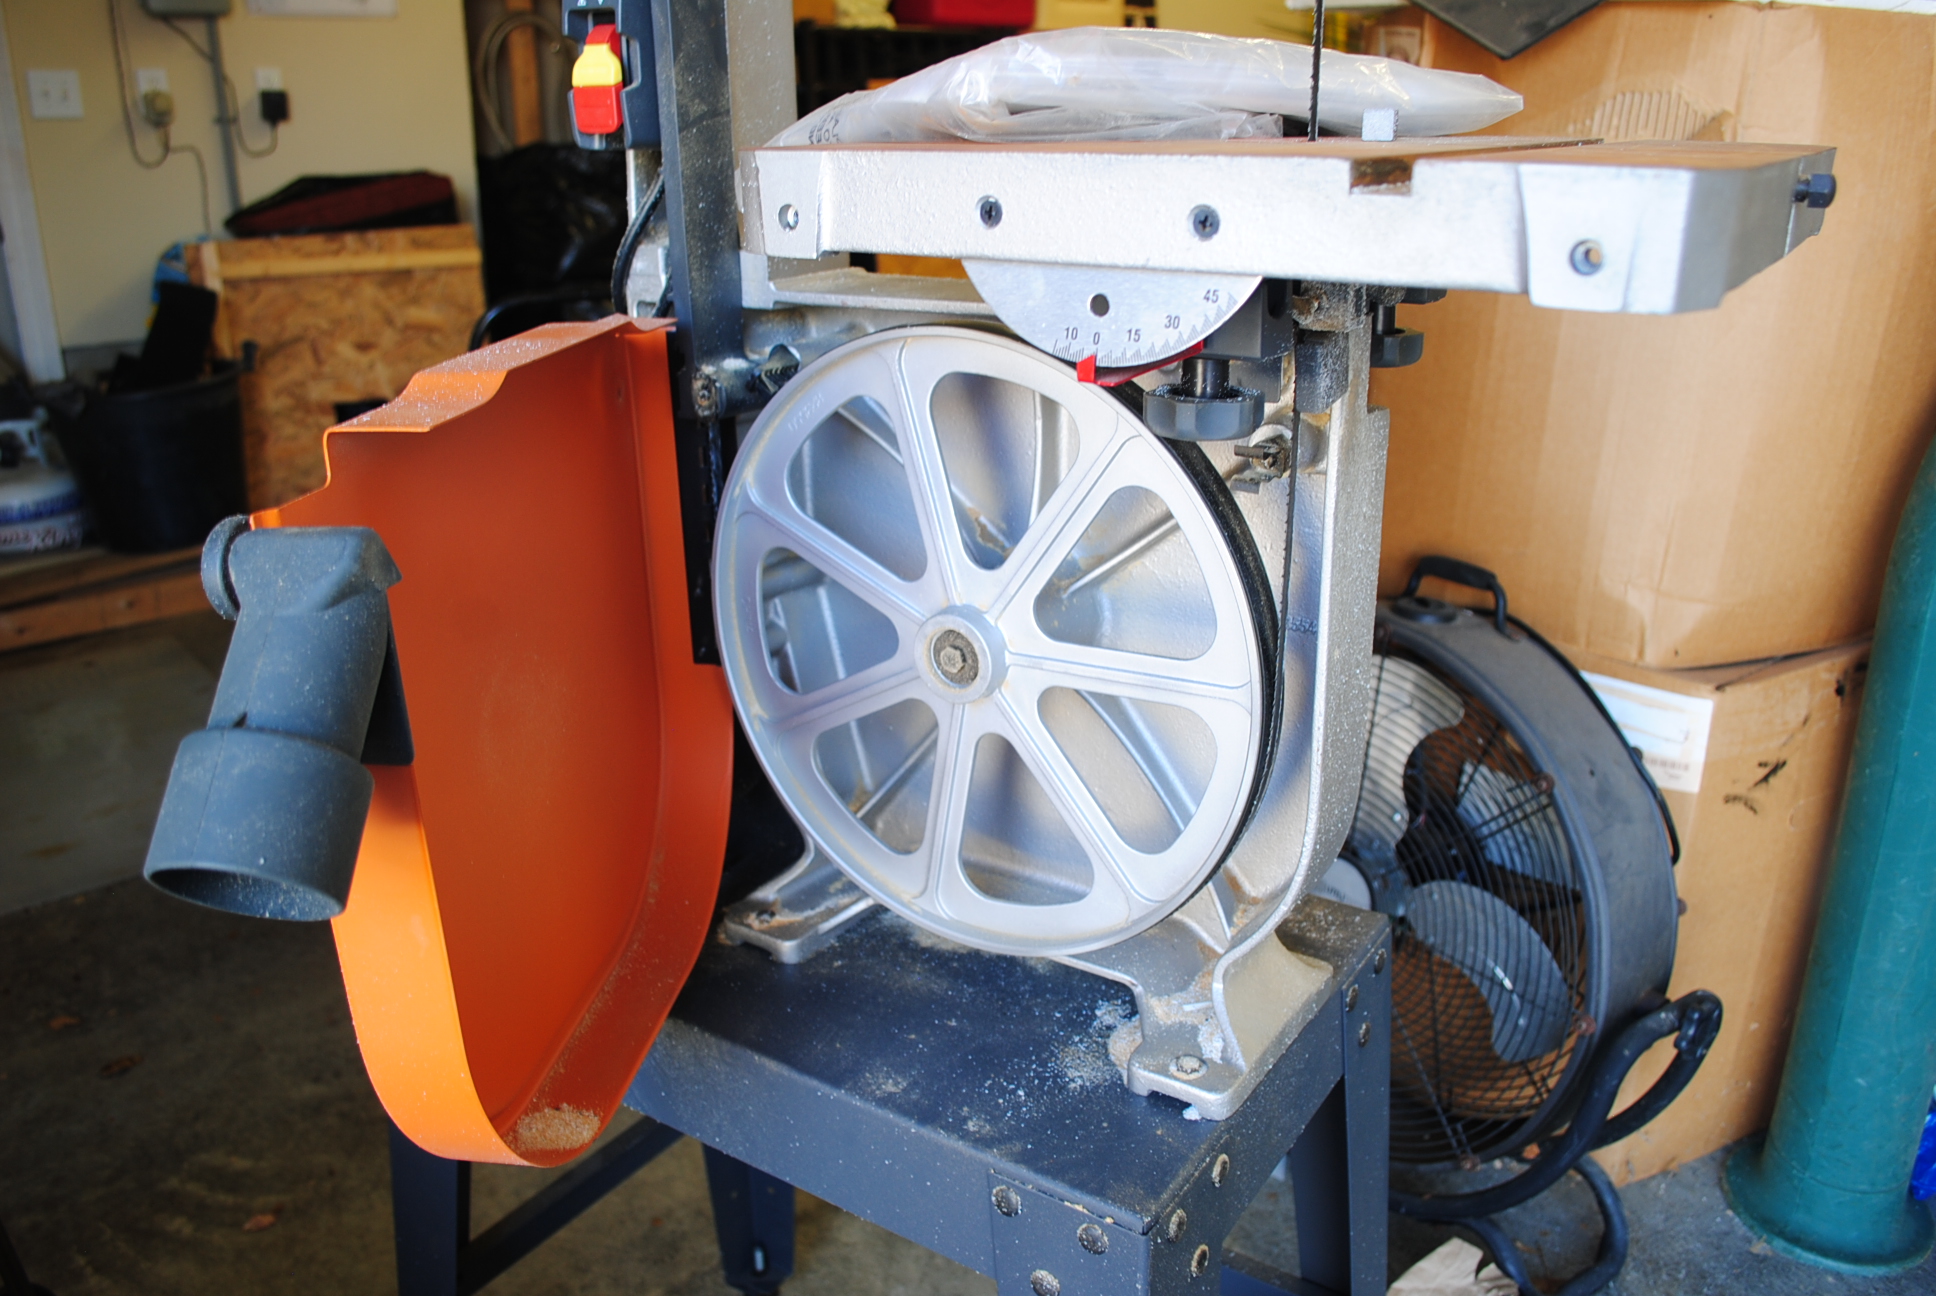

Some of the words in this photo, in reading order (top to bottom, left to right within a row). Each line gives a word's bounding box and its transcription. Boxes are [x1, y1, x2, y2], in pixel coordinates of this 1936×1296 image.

[1064, 327, 1079, 341] 10
[1093, 332, 1100, 345] 0
[1127, 328, 1142, 343] 15
[1164, 315, 1180, 330] 30
[1203, 289, 1219, 303] 45
